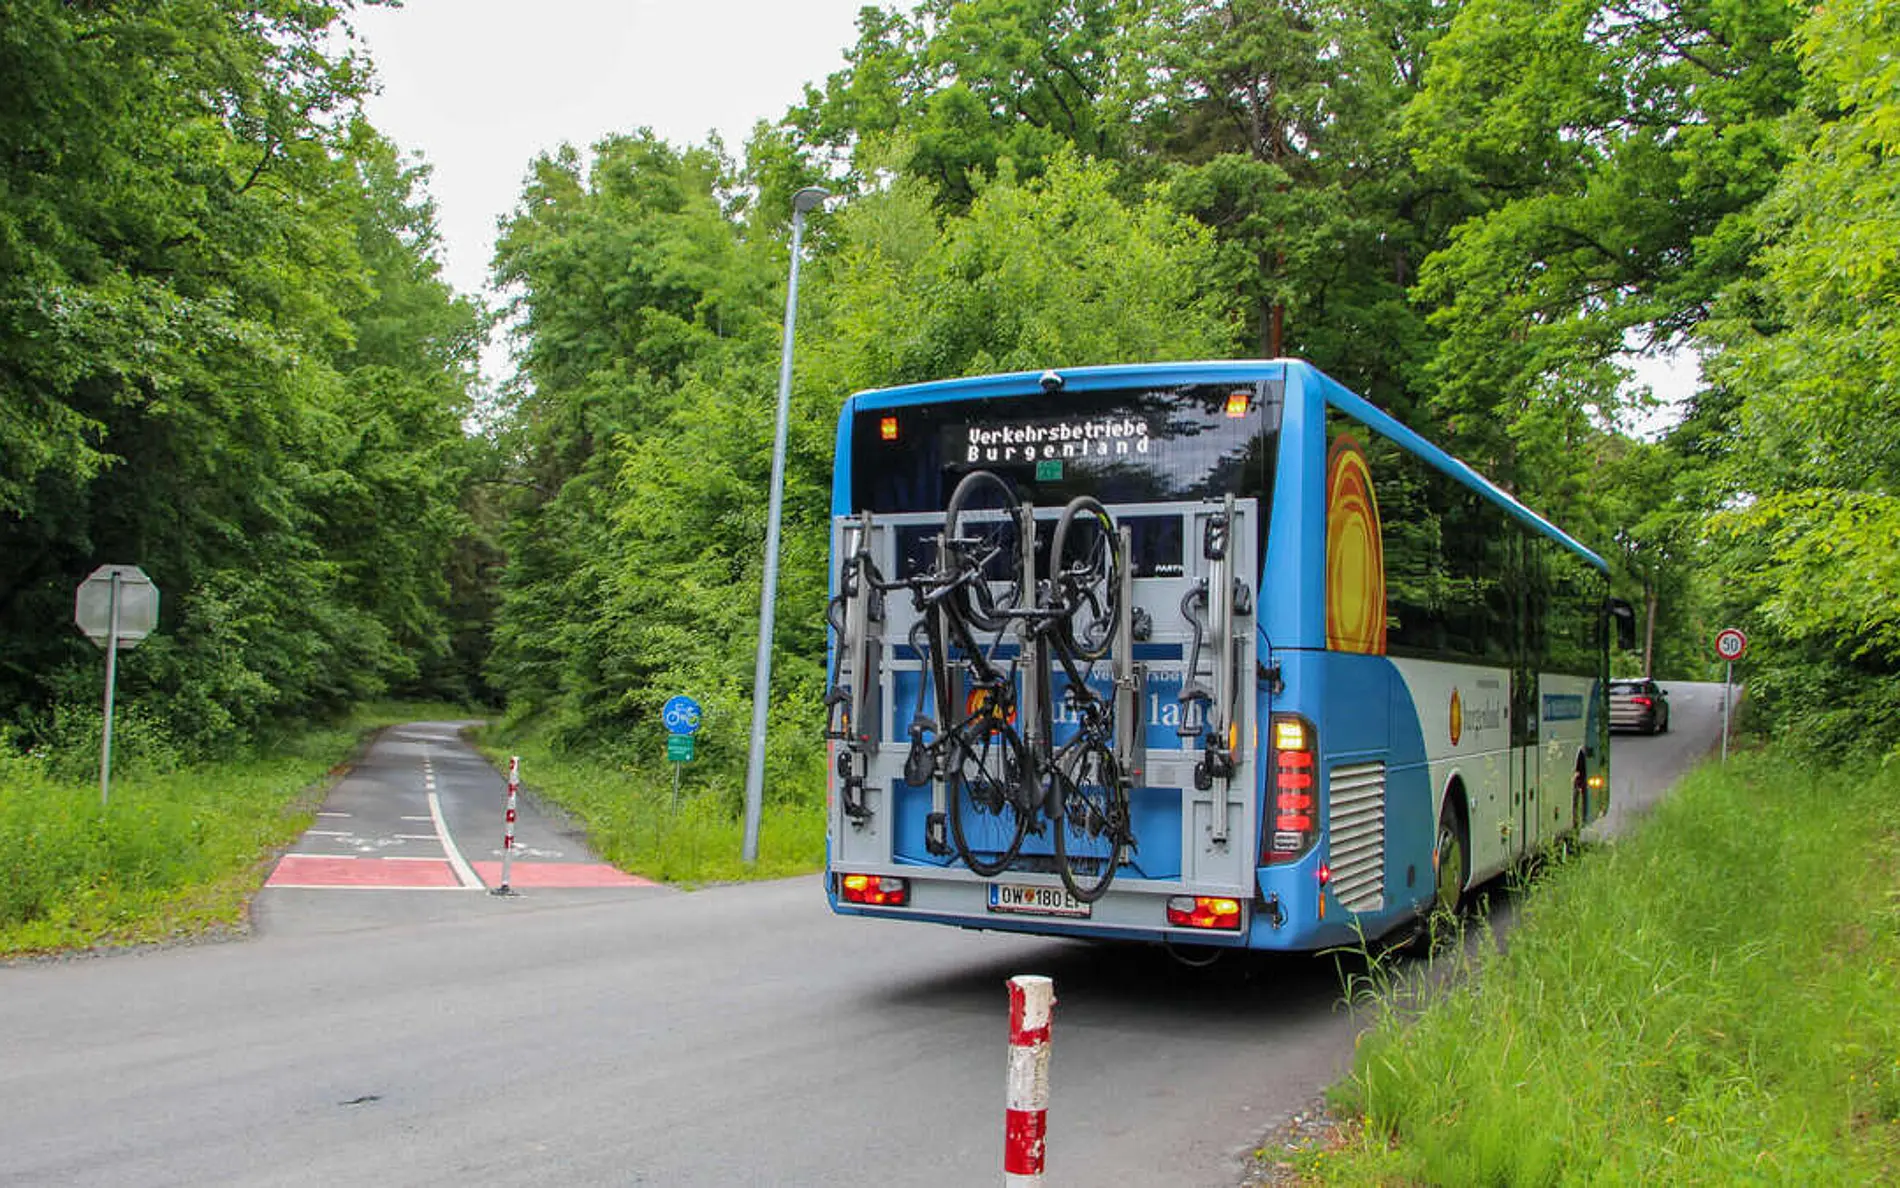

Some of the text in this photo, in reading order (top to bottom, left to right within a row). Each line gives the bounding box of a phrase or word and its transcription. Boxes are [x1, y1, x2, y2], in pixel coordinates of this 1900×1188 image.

[968, 419, 1149, 445] Verkehrsbetriebe
[967, 435, 1149, 463] Burgenland
[1723, 636, 1739, 652] 50
[1002, 887, 1023, 904] OW
[1036, 889, 1062, 908] 180
